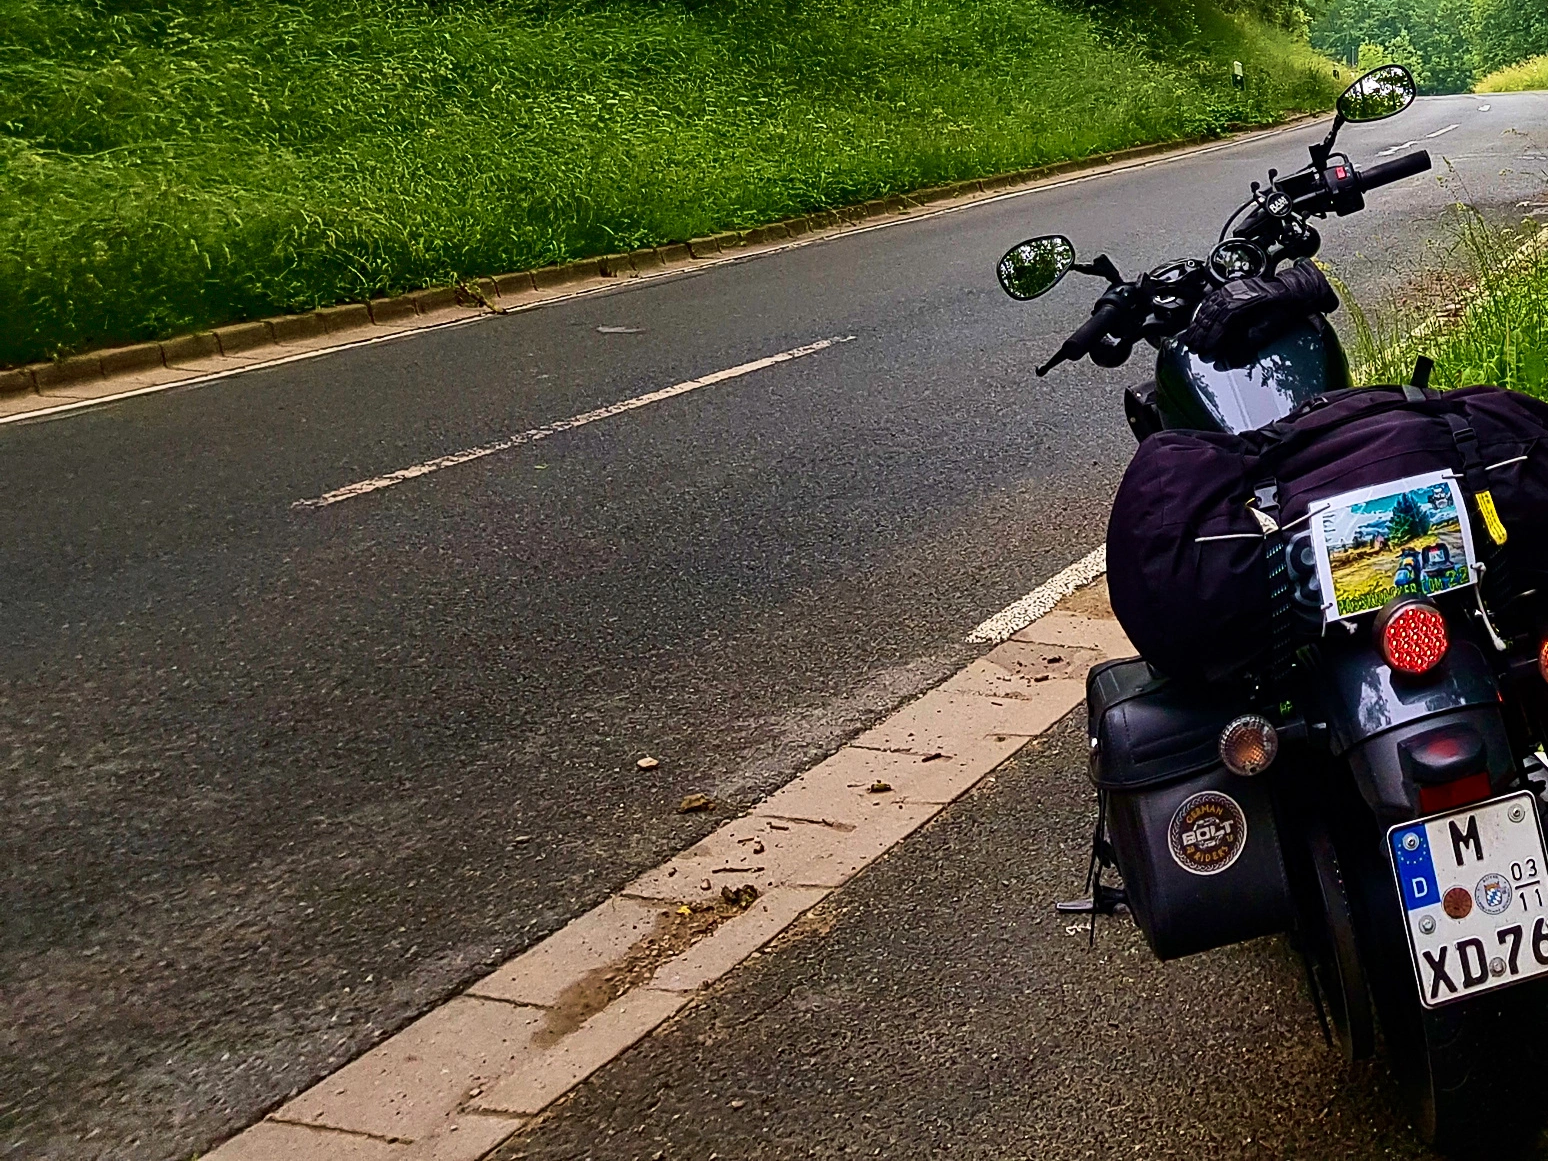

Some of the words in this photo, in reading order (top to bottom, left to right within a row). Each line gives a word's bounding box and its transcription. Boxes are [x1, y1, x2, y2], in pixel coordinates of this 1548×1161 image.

[1186, 804, 1223, 824] GERMAN
[1182, 820, 1234, 846] BOLT
[1448, 815, 1483, 866] M
[1194, 846, 1228, 862] RIDERS
[1511, 859, 1538, 881] 03
[1412, 877, 1428, 898] D
[1519, 889, 1543, 911] 11
[1422, 937, 1489, 999] XD
